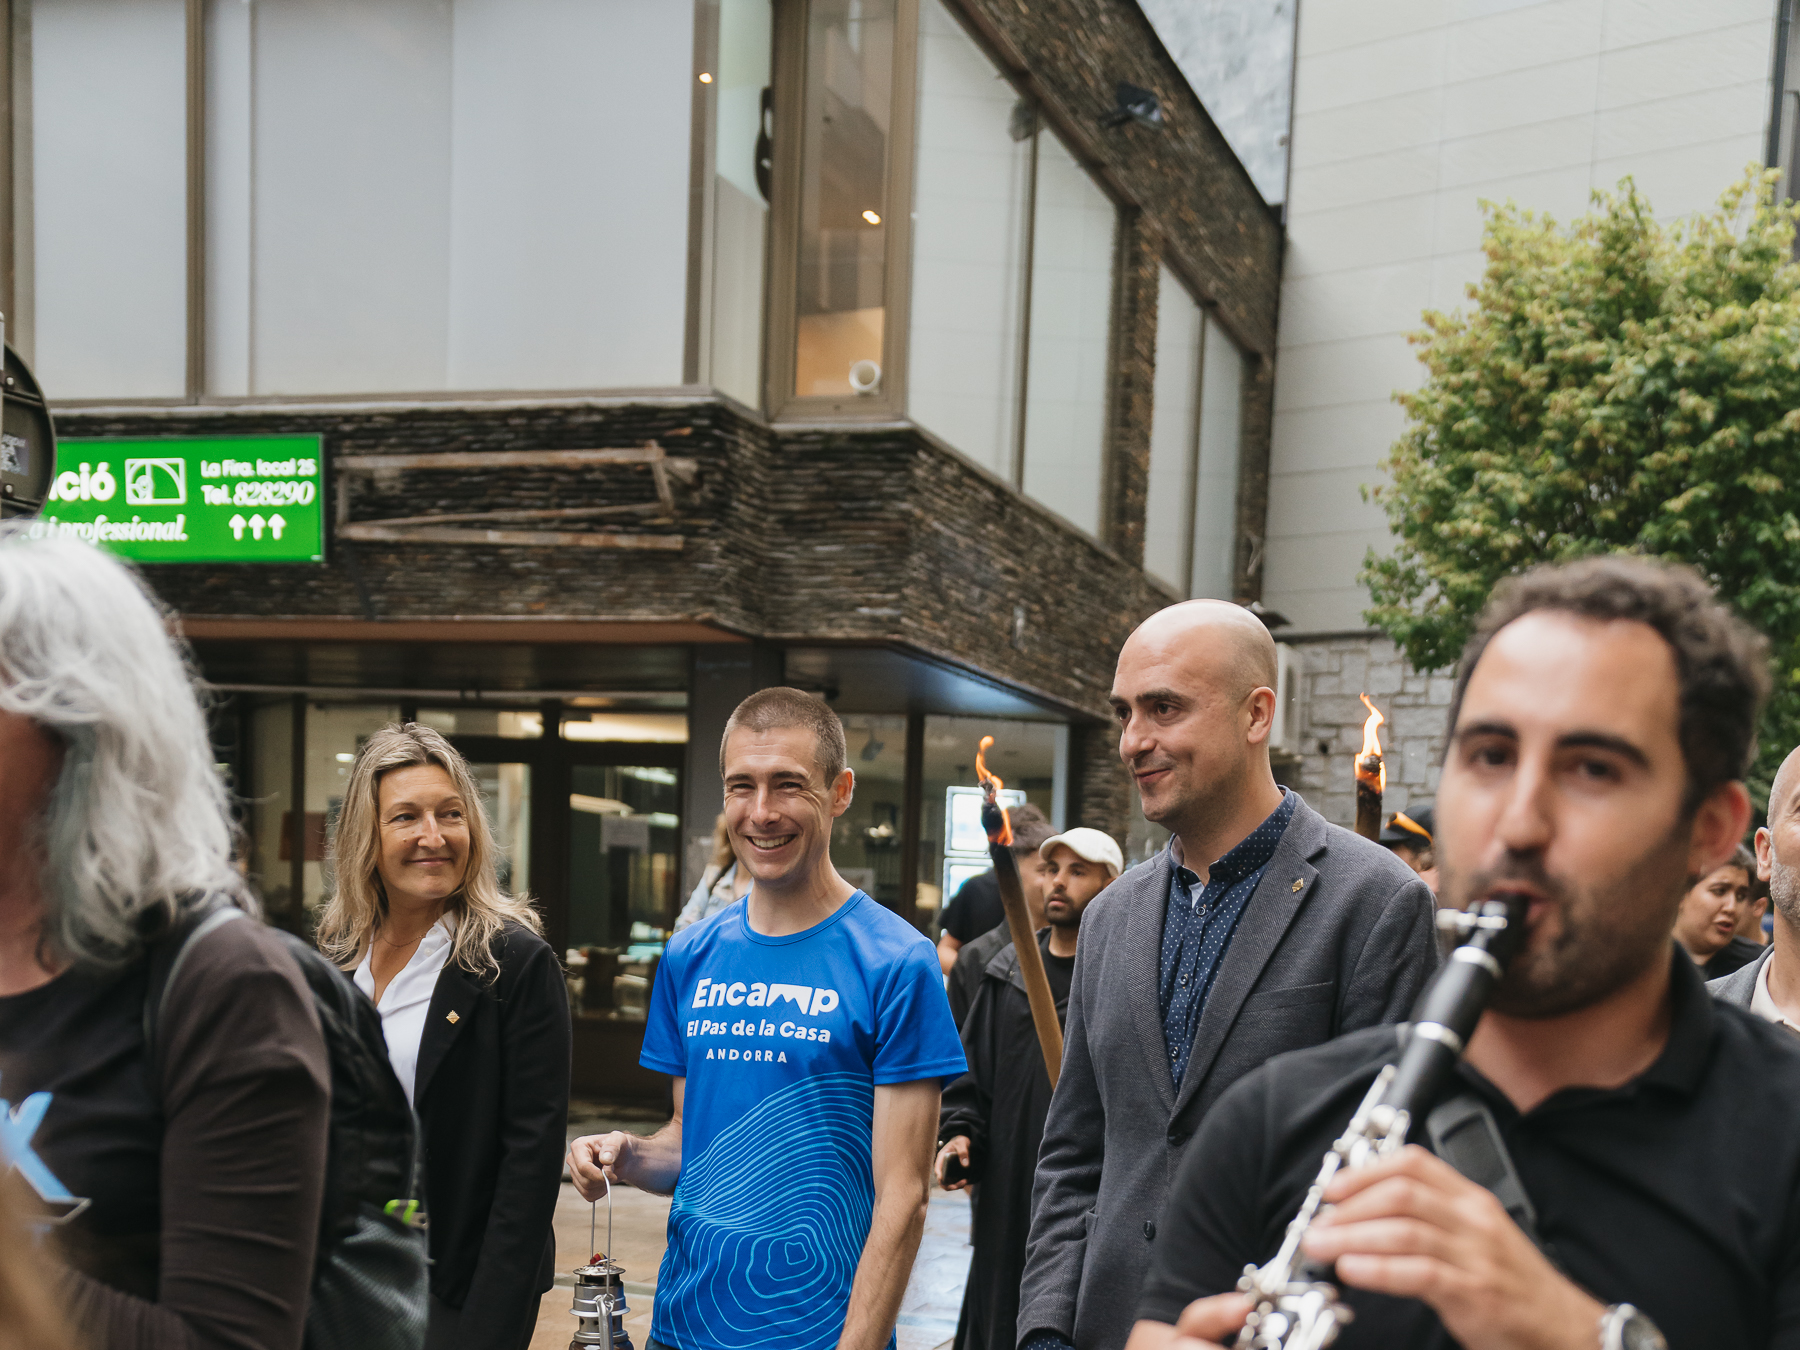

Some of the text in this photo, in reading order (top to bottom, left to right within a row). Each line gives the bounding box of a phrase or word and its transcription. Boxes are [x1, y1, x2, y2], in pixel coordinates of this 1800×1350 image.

[200, 460, 221, 477] La
[256, 458, 296, 477] local
[297, 458, 317, 477] 25
[200, 480, 316, 507] Tel. 828290
[692, 978, 839, 1016] Encamp
[687, 1018, 831, 1043] El Pas de la Casa
[706, 1048, 788, 1064] ANDORRA
